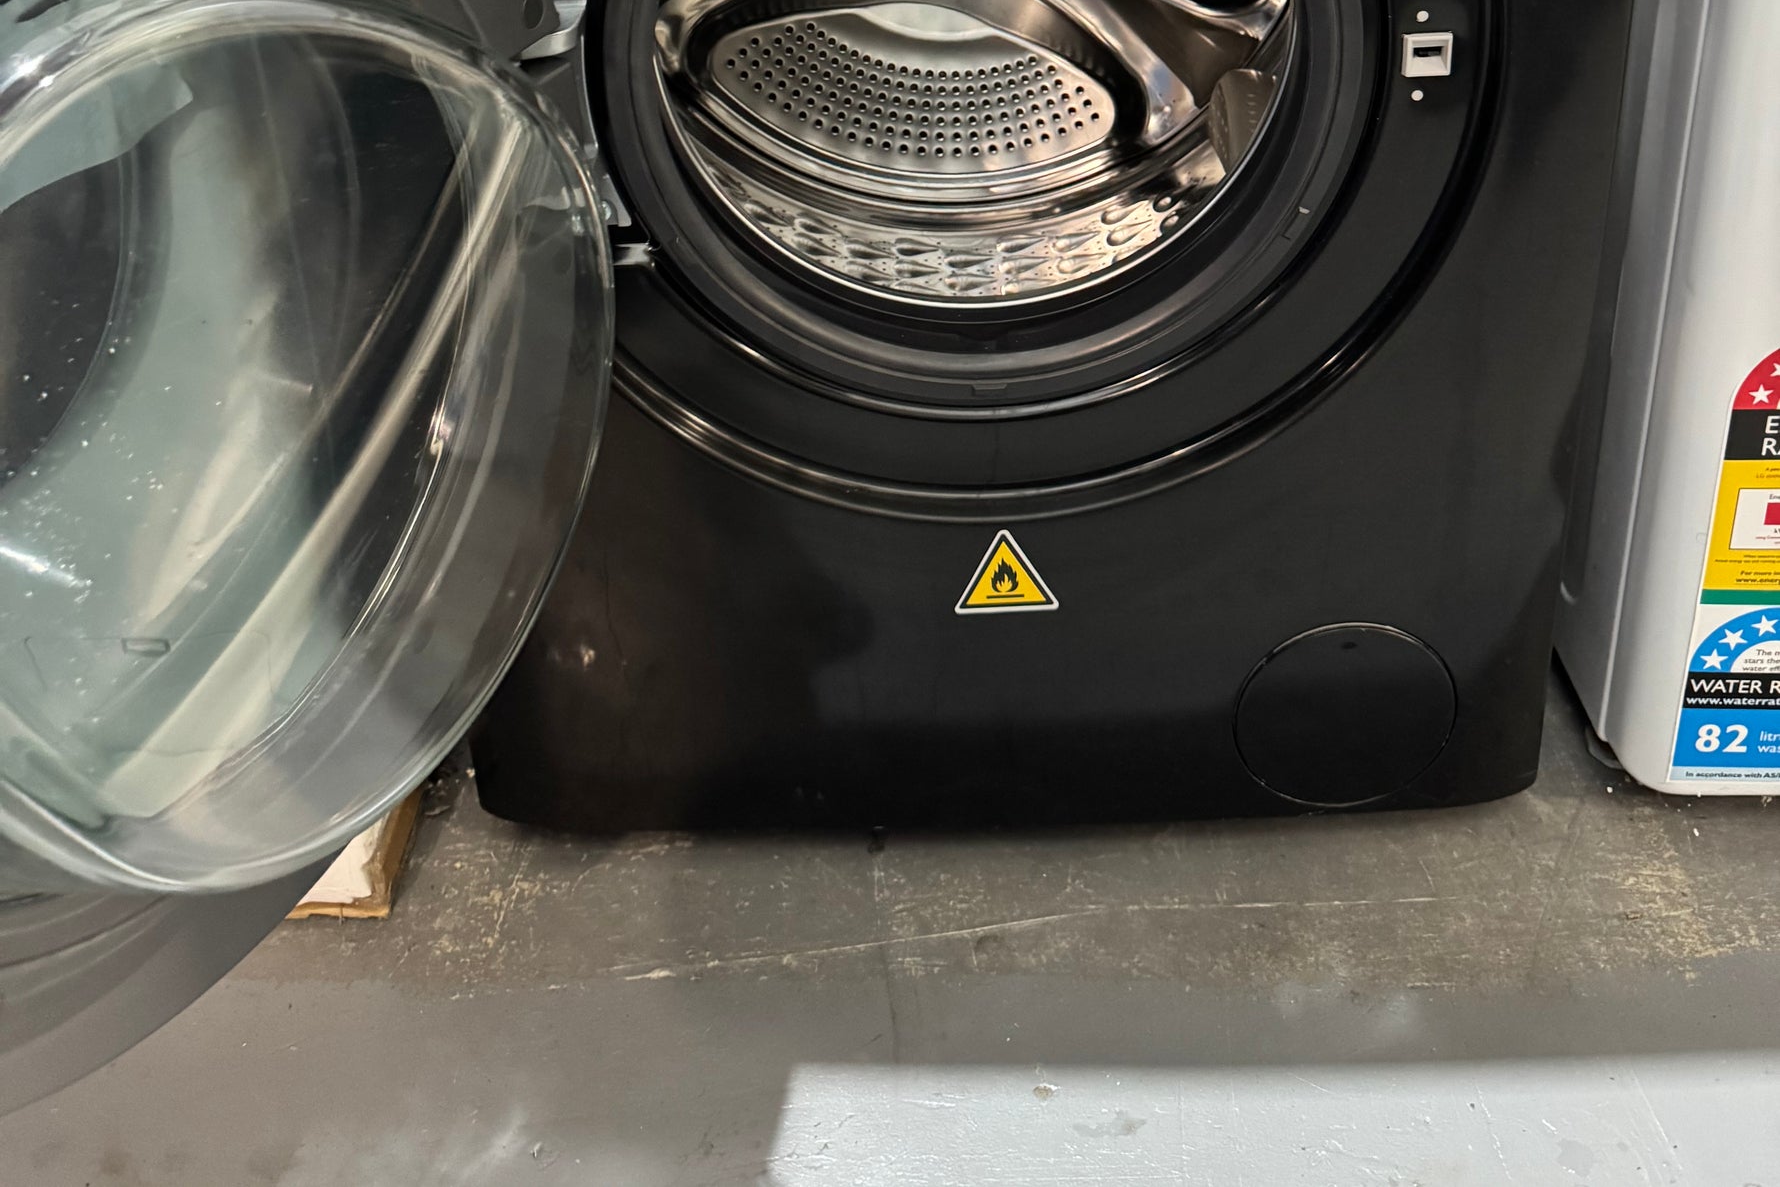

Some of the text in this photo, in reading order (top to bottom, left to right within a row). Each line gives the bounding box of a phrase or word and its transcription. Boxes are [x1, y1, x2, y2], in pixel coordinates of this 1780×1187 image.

[1761, 437, 1780, 456] R
[1690, 679, 1763, 694] WATER
[1695, 724, 1748, 753] 82
